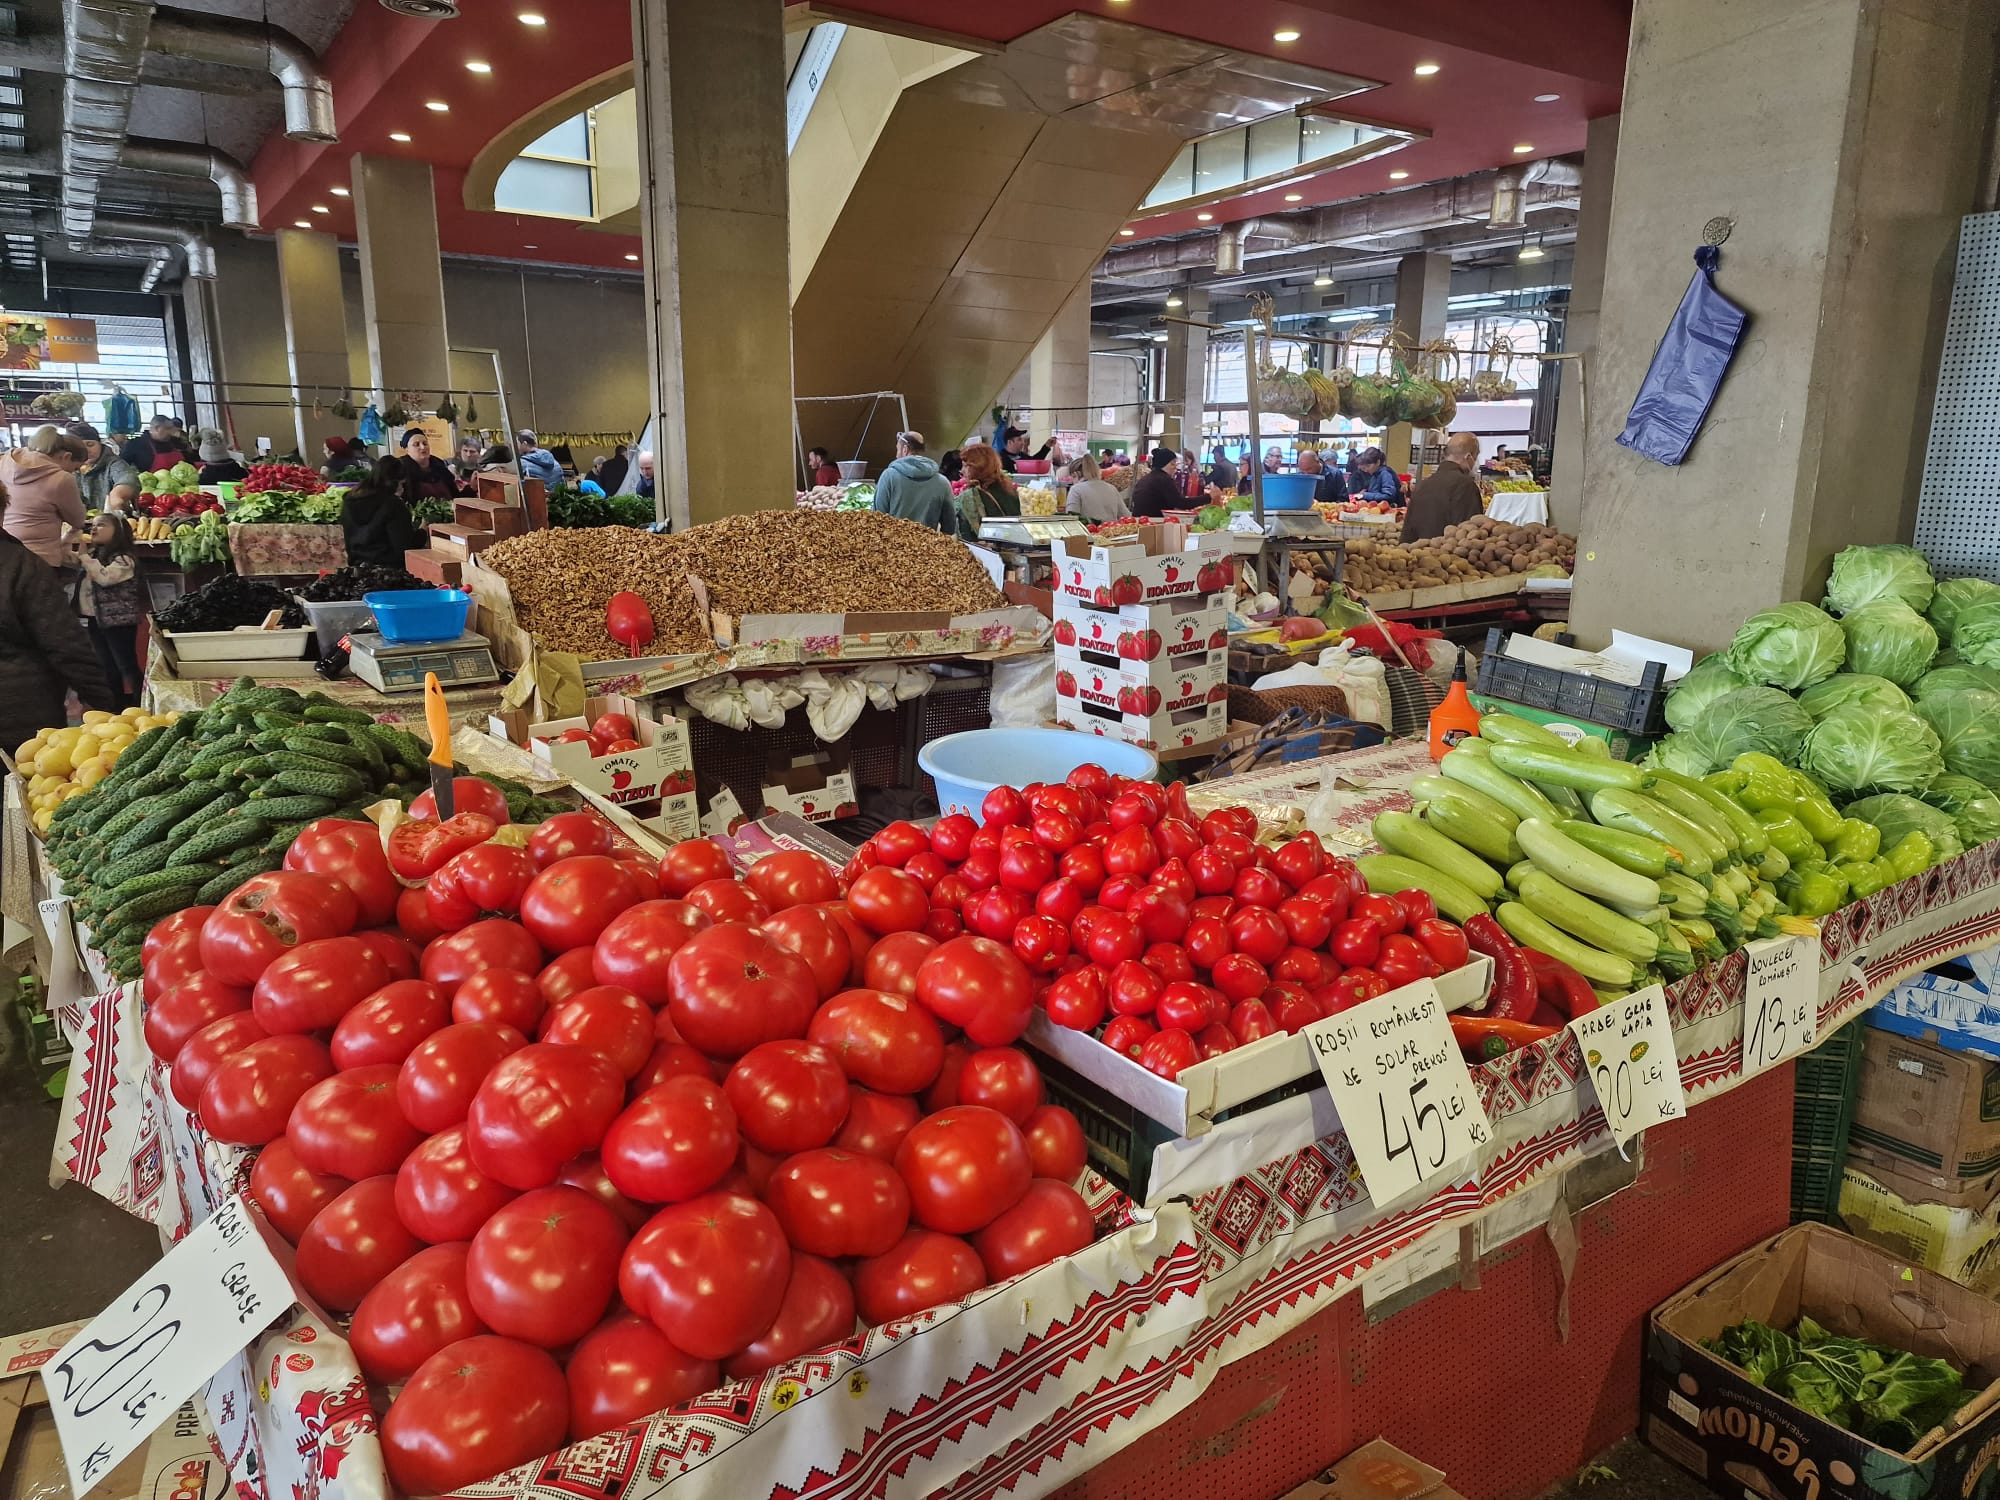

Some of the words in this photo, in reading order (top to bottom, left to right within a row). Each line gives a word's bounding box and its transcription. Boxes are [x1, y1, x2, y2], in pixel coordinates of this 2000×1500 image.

[1166, 639, 1206, 657] POLYZOU
[1748, 996, 1786, 1067] 13
[1802, 1029, 1813, 1047] KG
[1342, 1067, 1363, 1087] DE
[1375, 1039, 1420, 1075] SOLAR
[1596, 1060, 1632, 1134] 20
[1657, 1099, 1676, 1118] KG
[1378, 1078, 1446, 1183] 45
[1467, 1122, 1487, 1145] KG
[1842, 1173, 1889, 1197] PREMIUM
[220, 1262, 262, 1324] GRASE
[54, 1283, 179, 1418] 20
[173, 1399, 200, 1437] PREM
[1762, 1406, 1811, 1445] PREMIUM
[79, 1440, 115, 1483] KG
